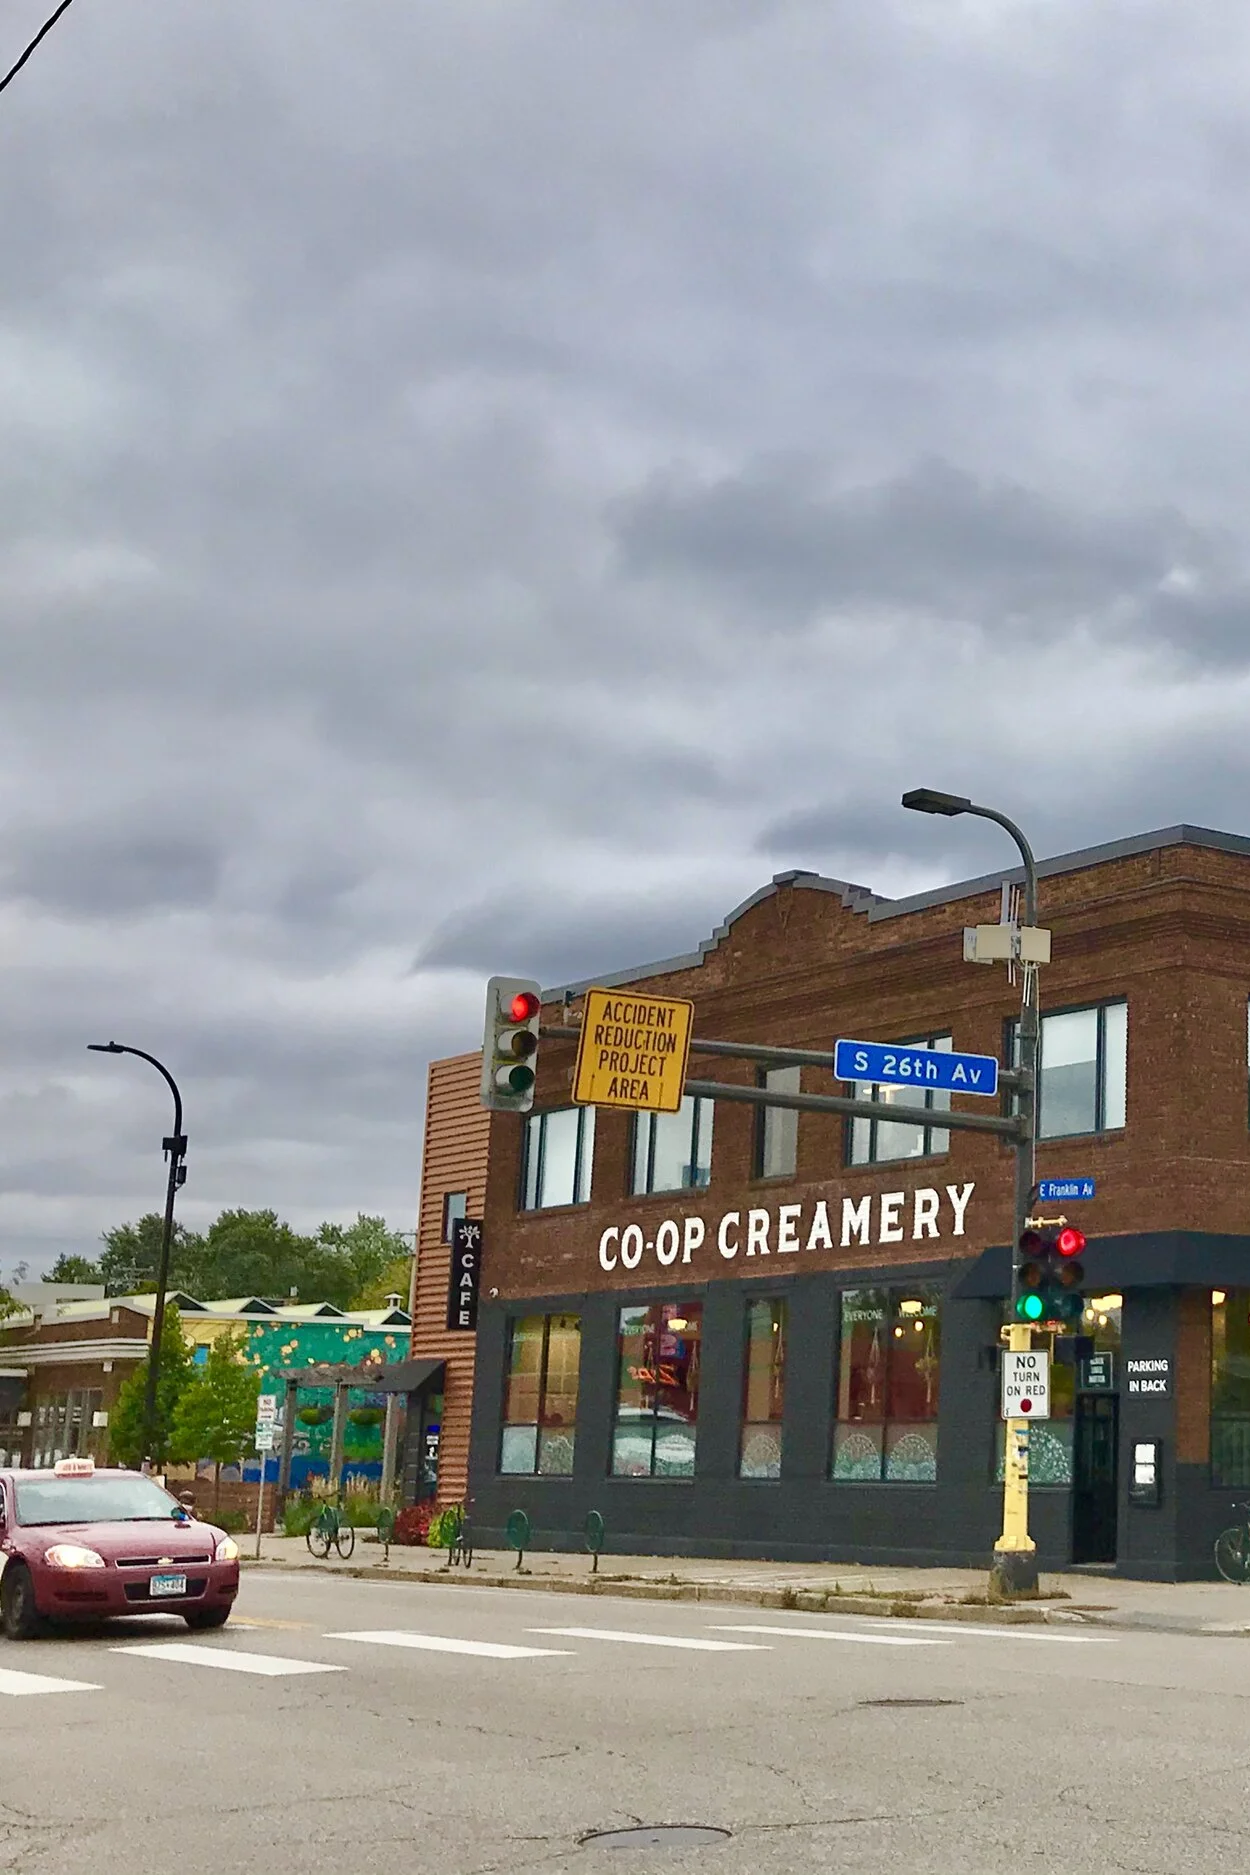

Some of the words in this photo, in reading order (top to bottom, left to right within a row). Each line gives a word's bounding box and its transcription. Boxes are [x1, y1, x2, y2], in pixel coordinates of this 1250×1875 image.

[602, 1000, 676, 1028] ACCIDENT
[594, 1024, 677, 1054] REDUCTION
[598, 1049, 667, 1077] PROJECT
[854, 1051, 868, 1072] S
[882, 1054, 938, 1080] 26th
[951, 1063, 982, 1084] Av
[607, 1077, 649, 1101] AREA
[1039, 1184, 1046, 1197] E
[1049, 1183, 1079, 1197] Franklin
[1082, 1182, 1093, 1196] Av
[599, 1216, 705, 1271] CO-OP
[717, 1182, 976, 1259] CREAMERY
[458, 1253, 475, 1326] CAFE
[843, 1308, 883, 1322] EVERYONE
[1016, 1355, 1036, 1369] NO
[1127, 1359, 1169, 1373] PARKING
[1013, 1371, 1040, 1382] TURN
[1129, 1380, 1140, 1392] IN
[1141, 1379, 1167, 1392] BACK
[1006, 1385, 1021, 1397] ON
[1025, 1384, 1046, 1396] RED
